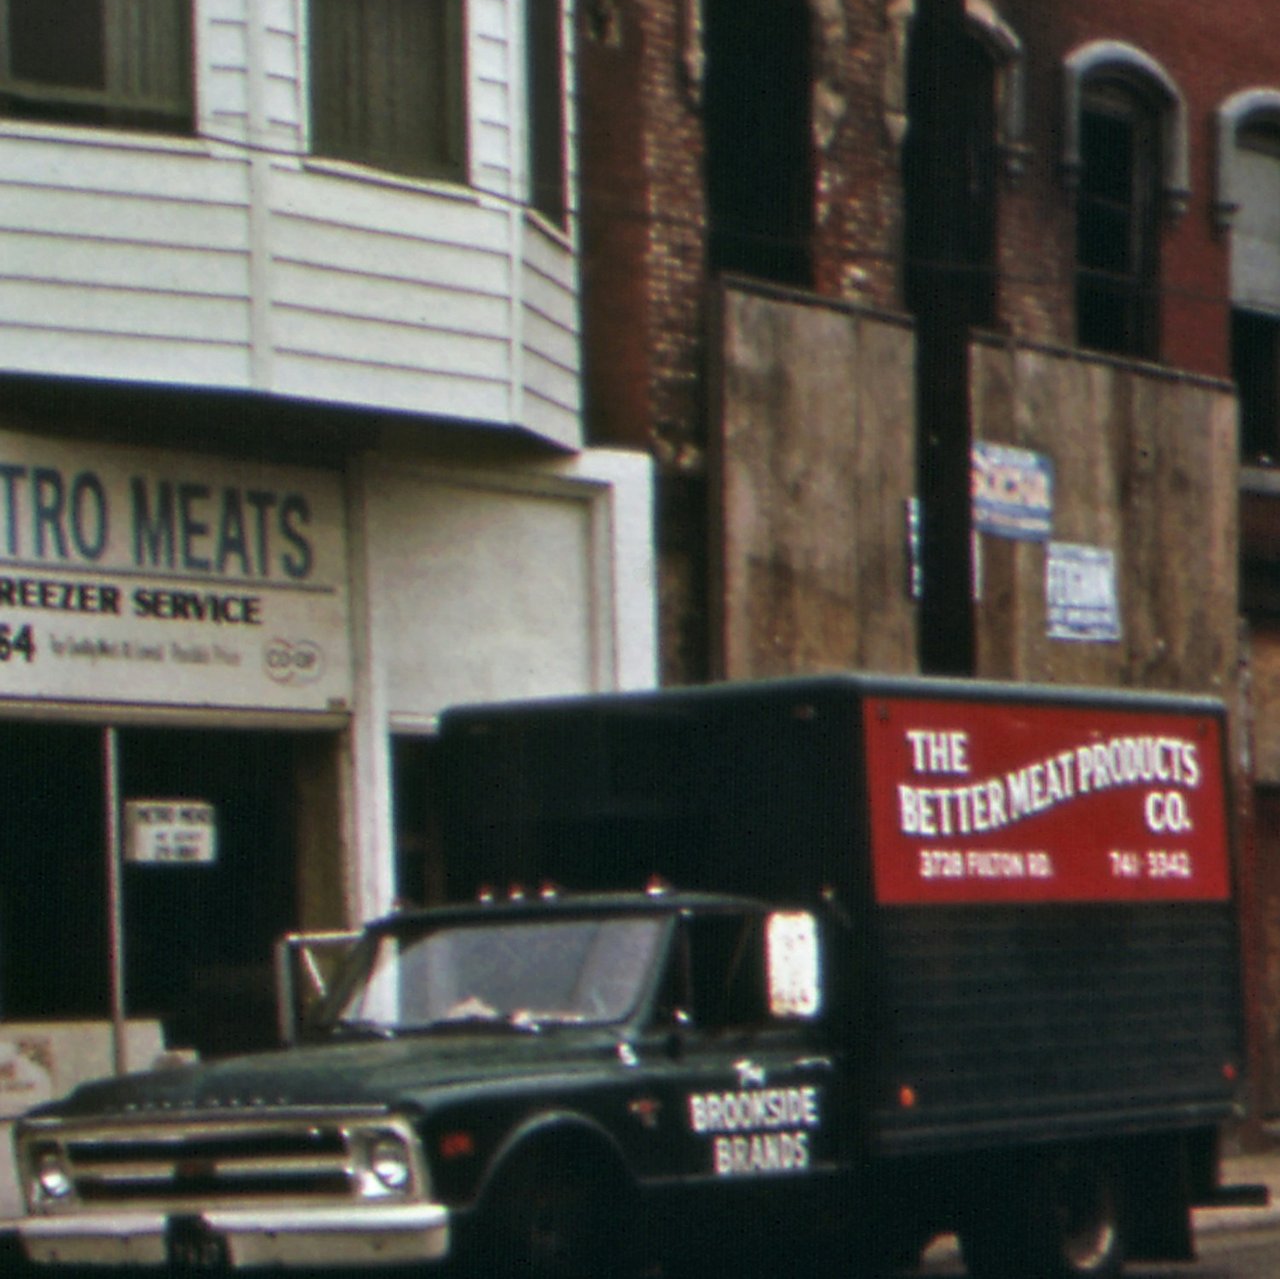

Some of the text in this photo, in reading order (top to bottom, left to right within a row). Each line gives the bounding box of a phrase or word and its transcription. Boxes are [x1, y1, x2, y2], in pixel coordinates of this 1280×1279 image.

[130, 475, 312, 578] MEATS
[133, 588, 262, 624] SERVICE
[905, 729, 970, 774] THE
[898, 735, 1201, 837] BETTER MEAT PRODUCTS
[1143, 791, 1193, 832] CO.
[688, 1086, 819, 1134] BROOKSIDE
[714, 1131, 809, 1175] BRANDS
